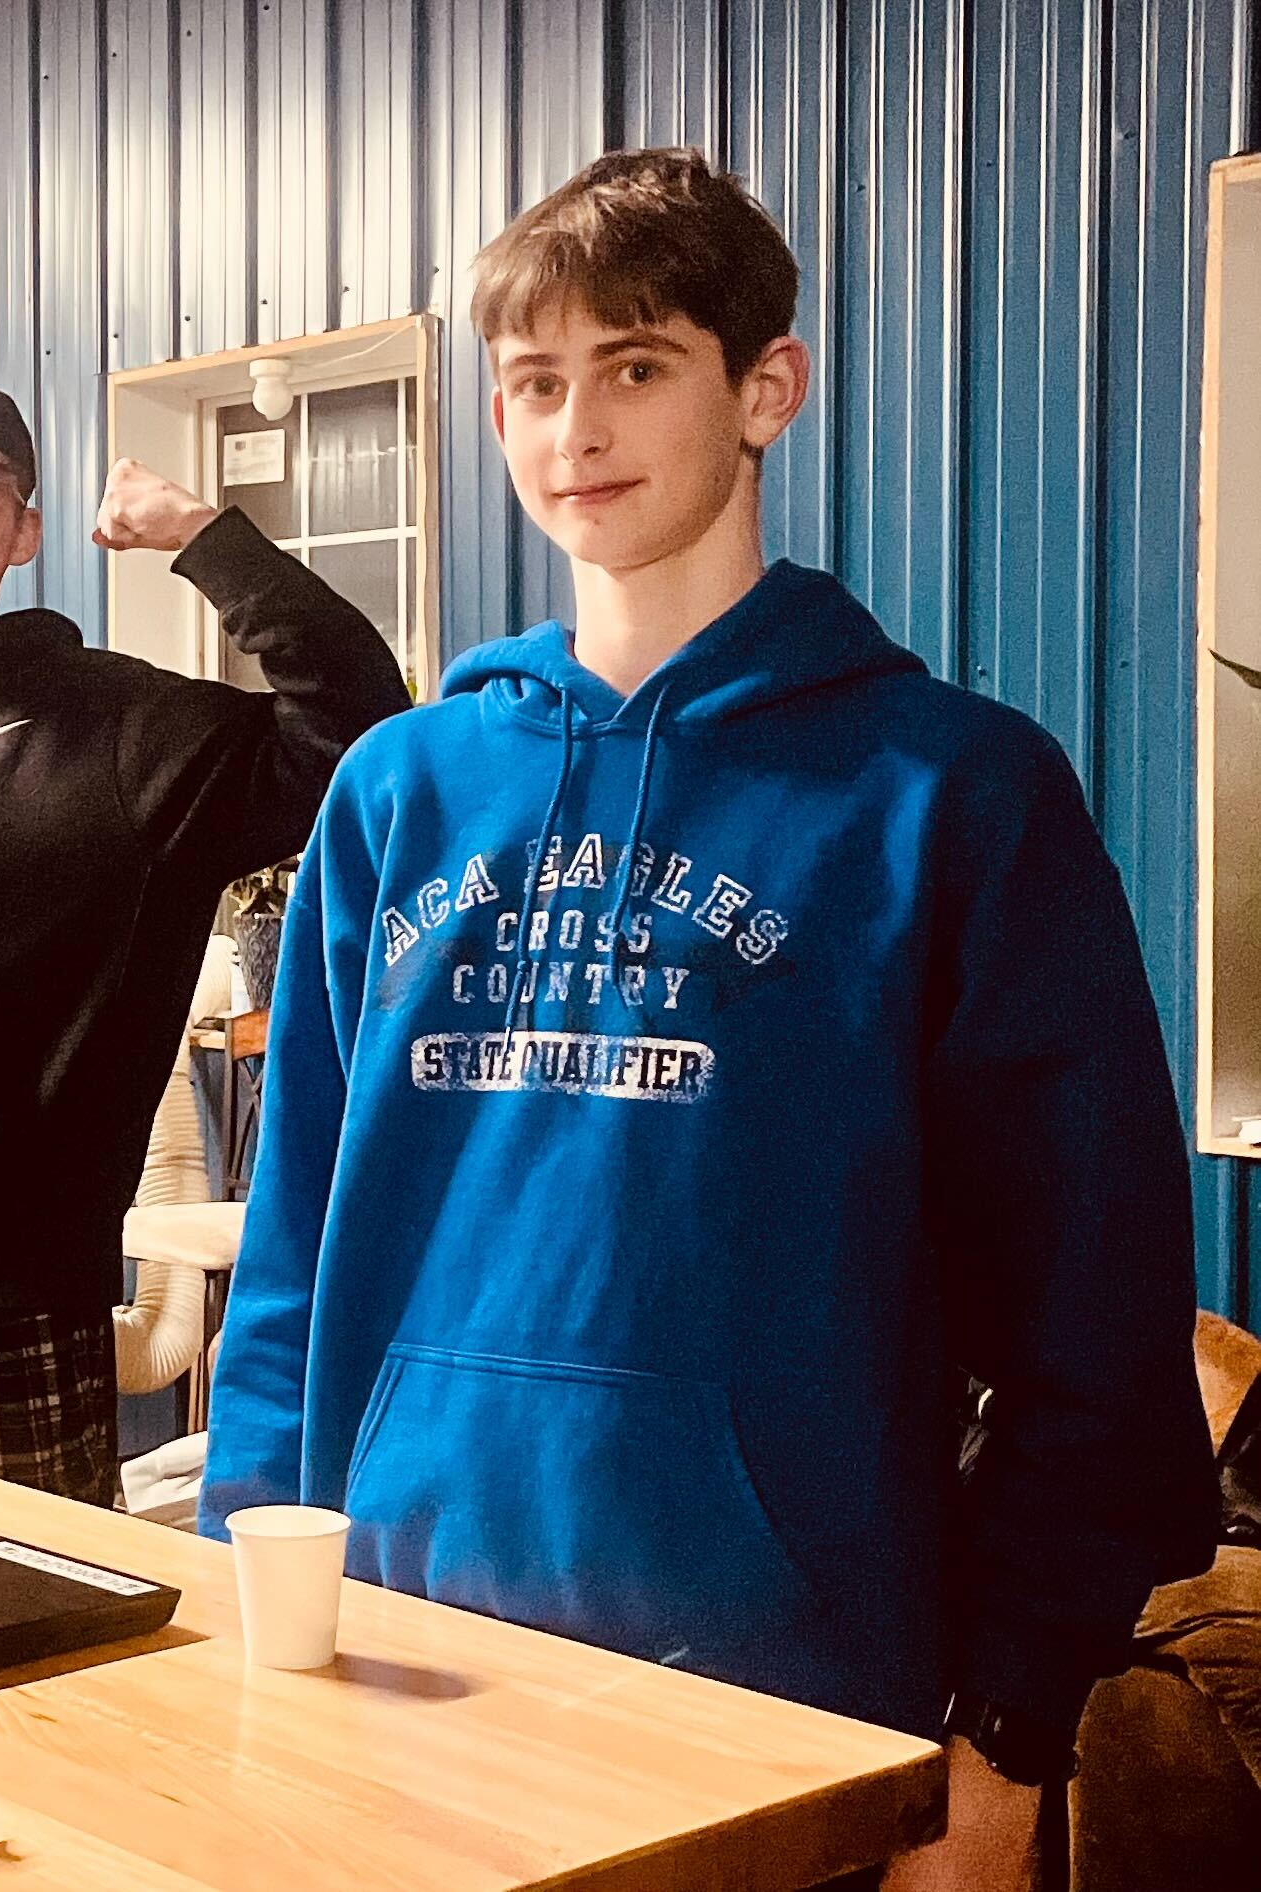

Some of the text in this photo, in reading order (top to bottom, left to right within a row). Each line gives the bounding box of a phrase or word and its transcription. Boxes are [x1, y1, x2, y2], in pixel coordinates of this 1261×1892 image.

[380, 833, 790, 967] ACA EAGLES
[496, 909, 653, 953] CROSS
[452, 961, 690, 1009] COUNTRY
[423, 1039, 706, 1097] STATE QUALIFIER
